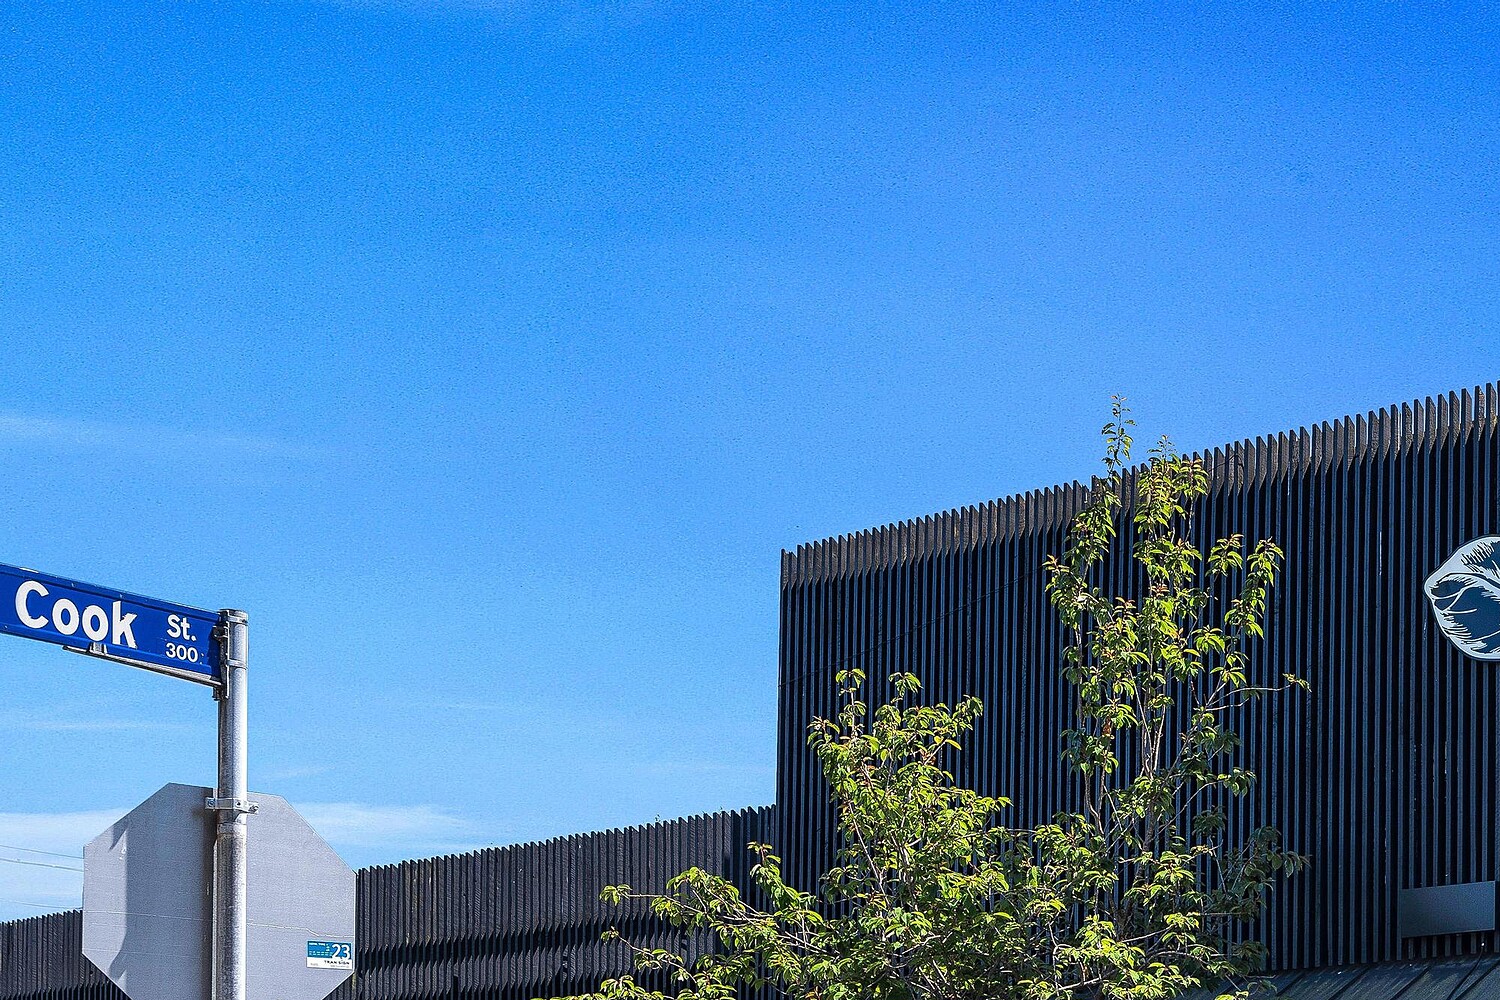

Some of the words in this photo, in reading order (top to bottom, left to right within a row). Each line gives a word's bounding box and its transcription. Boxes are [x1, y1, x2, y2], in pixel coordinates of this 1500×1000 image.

[15, 580, 138, 649] Cook
[166, 614, 197, 642] St.
[165, 642, 198, 663] 300
[331, 944, 350, 960] 23
